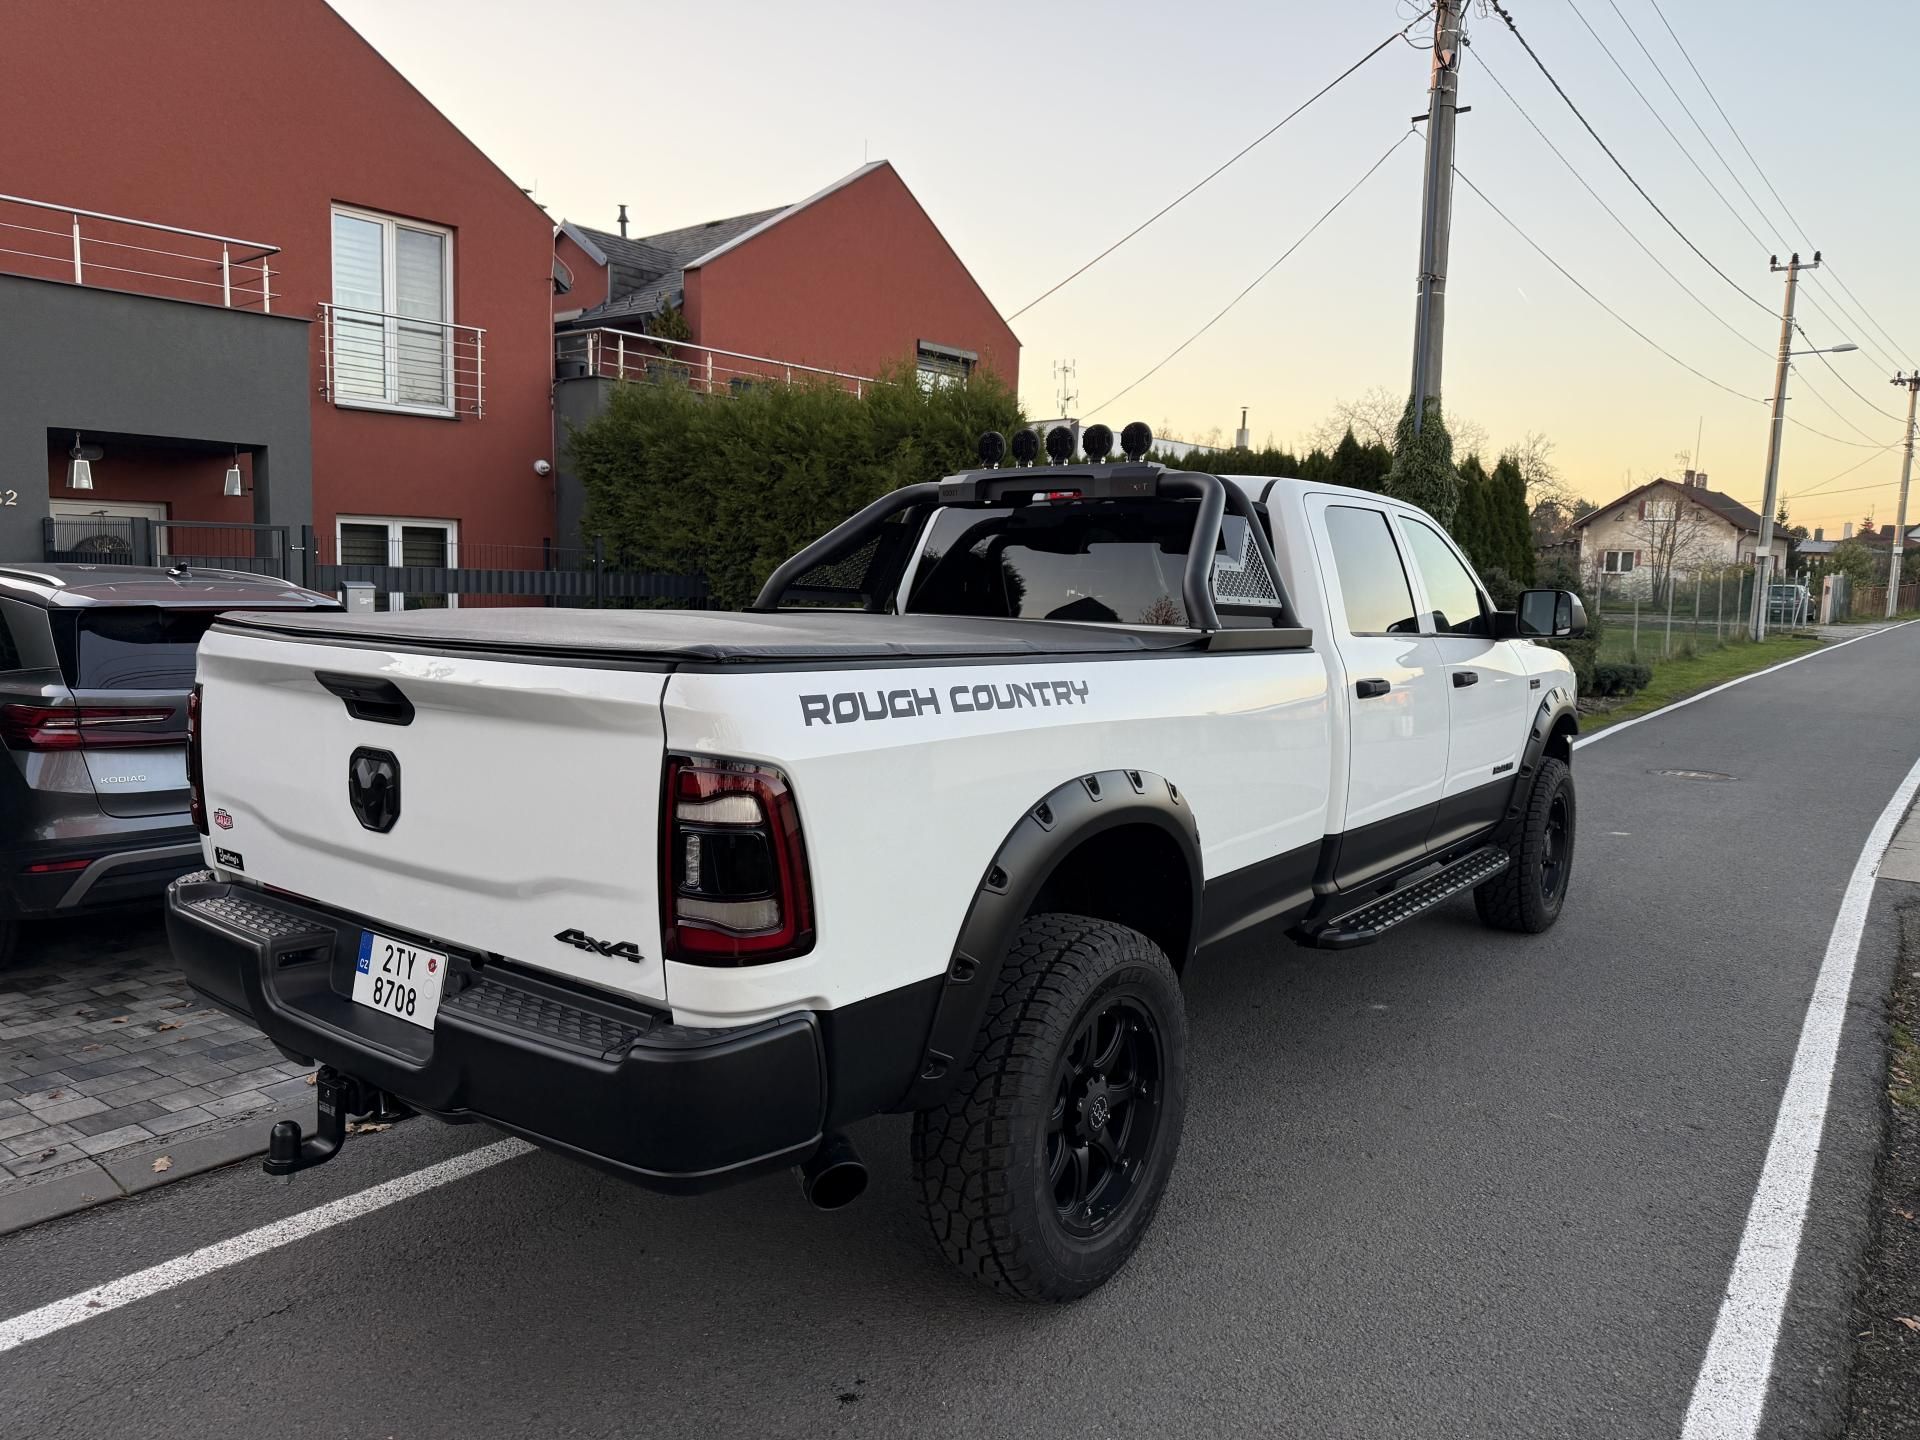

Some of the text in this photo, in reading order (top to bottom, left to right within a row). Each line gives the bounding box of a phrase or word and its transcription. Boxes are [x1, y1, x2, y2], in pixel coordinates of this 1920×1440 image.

[798, 679, 1090, 727] ROUGH COUNTRY
[100, 774, 147, 784] KODIAQ
[359, 958, 369, 970] CZ
[382, 944, 417, 980] 2TY
[373, 976, 417, 1017] 8708
